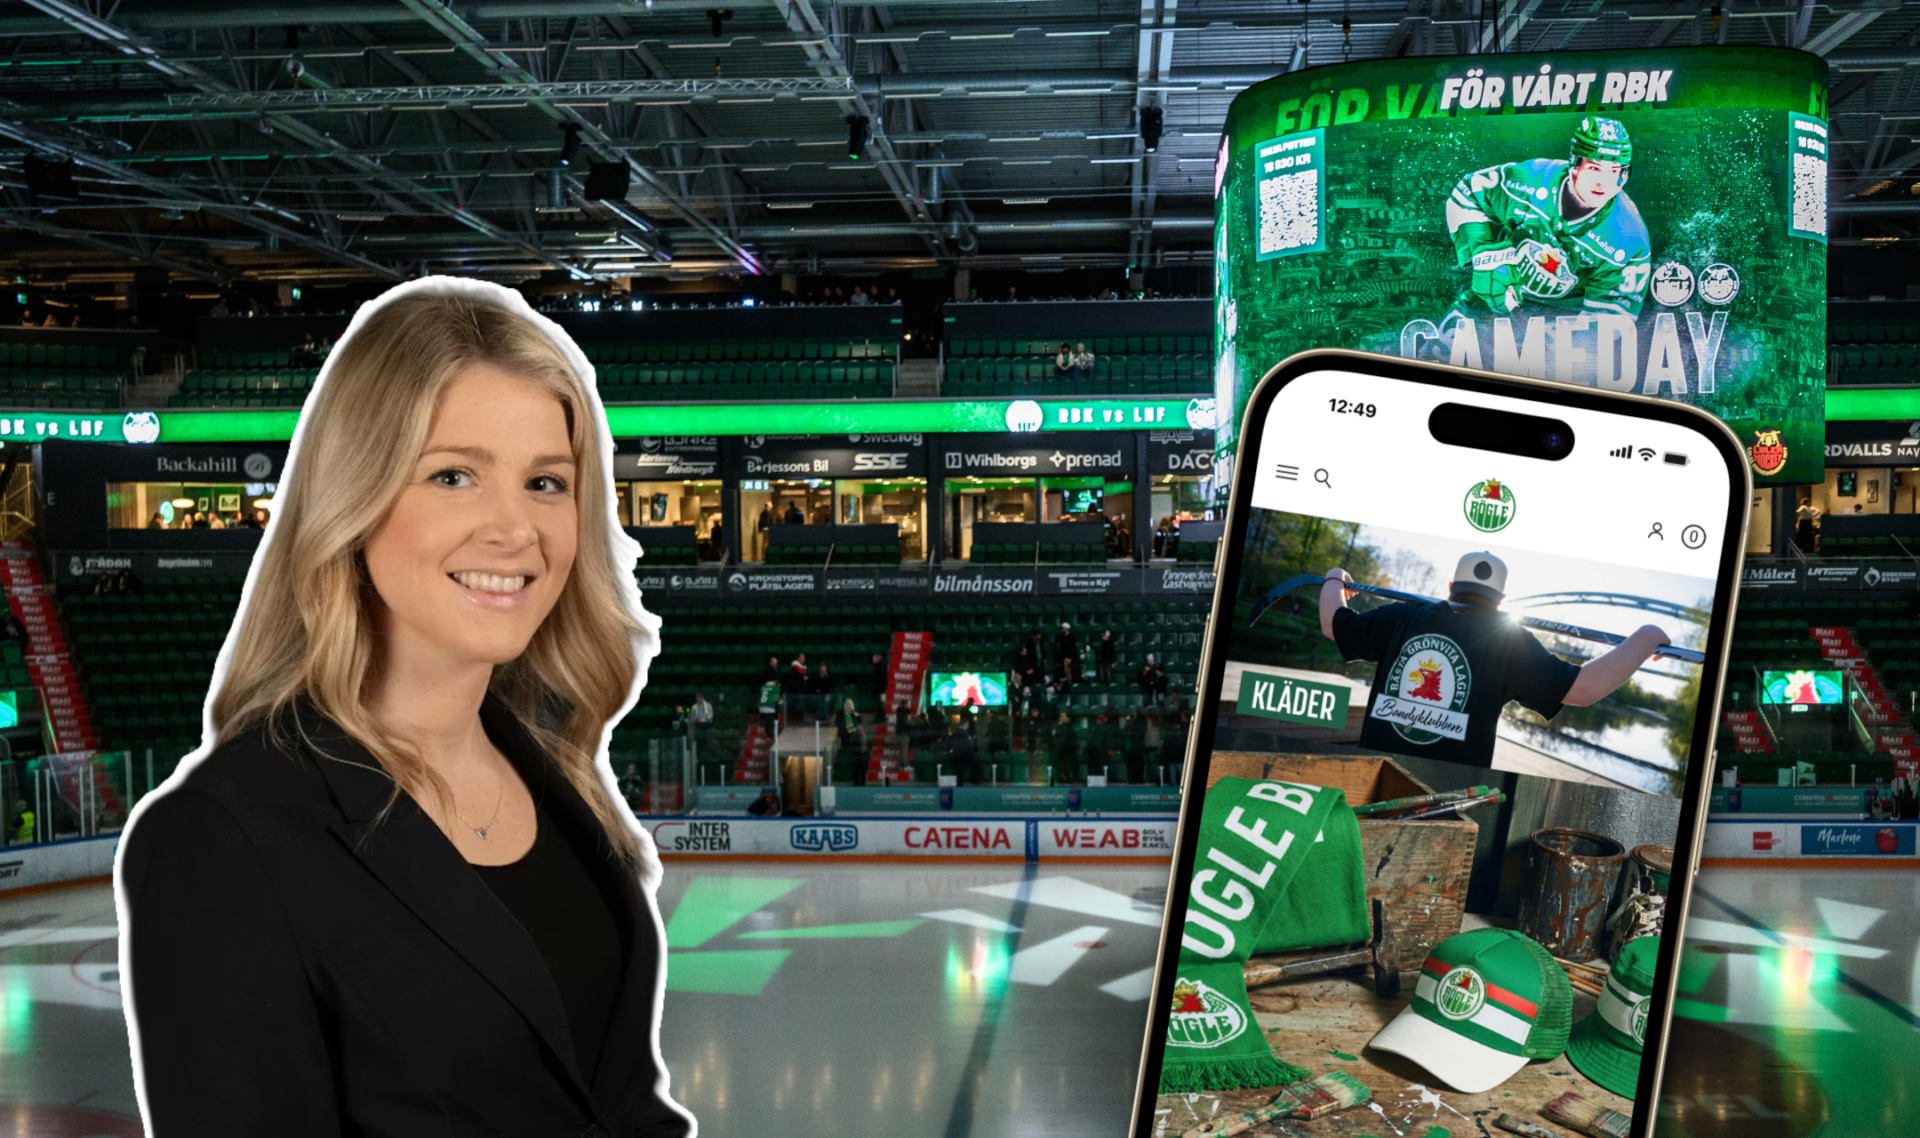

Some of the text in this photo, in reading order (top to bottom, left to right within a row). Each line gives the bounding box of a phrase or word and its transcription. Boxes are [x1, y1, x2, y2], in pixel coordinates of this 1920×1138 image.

[1440, 64, 1673, 109] FÖR VÅRT RBK
[1618, 263, 1651, 294] 37
[1328, 397, 1377, 419] 12:49
[157, 456, 237, 472] Backahill
[813, 459, 829, 472] Bil
[853, 453, 910, 471] SSE
[965, 453, 1037, 469] Wihlborgs
[1066, 450, 1121, 471] prenad
[1469, 500, 1509, 528] RÖGLE
[1690, 529, 1699, 543] 0
[934, 574, 1033, 593] bilmånsson
[1749, 568, 1796, 579] Måleri
[1390, 636, 1468, 706] BÄSTA GRÖNVITA LAGET
[1251, 680, 1336, 721] KLÄDER
[1375, 698, 1464, 735] Bandyklubben
[689, 822, 729, 836] INTER
[795, 828, 855, 847] KAABS
[905, 827, 1012, 849] CATENA
[1053, 828, 1140, 848] WEAB
[1817, 828, 1861, 849] Marlene
[675, 836, 731, 851] SYSTEM
[1168, 1013, 1233, 1045] ÖGLE
